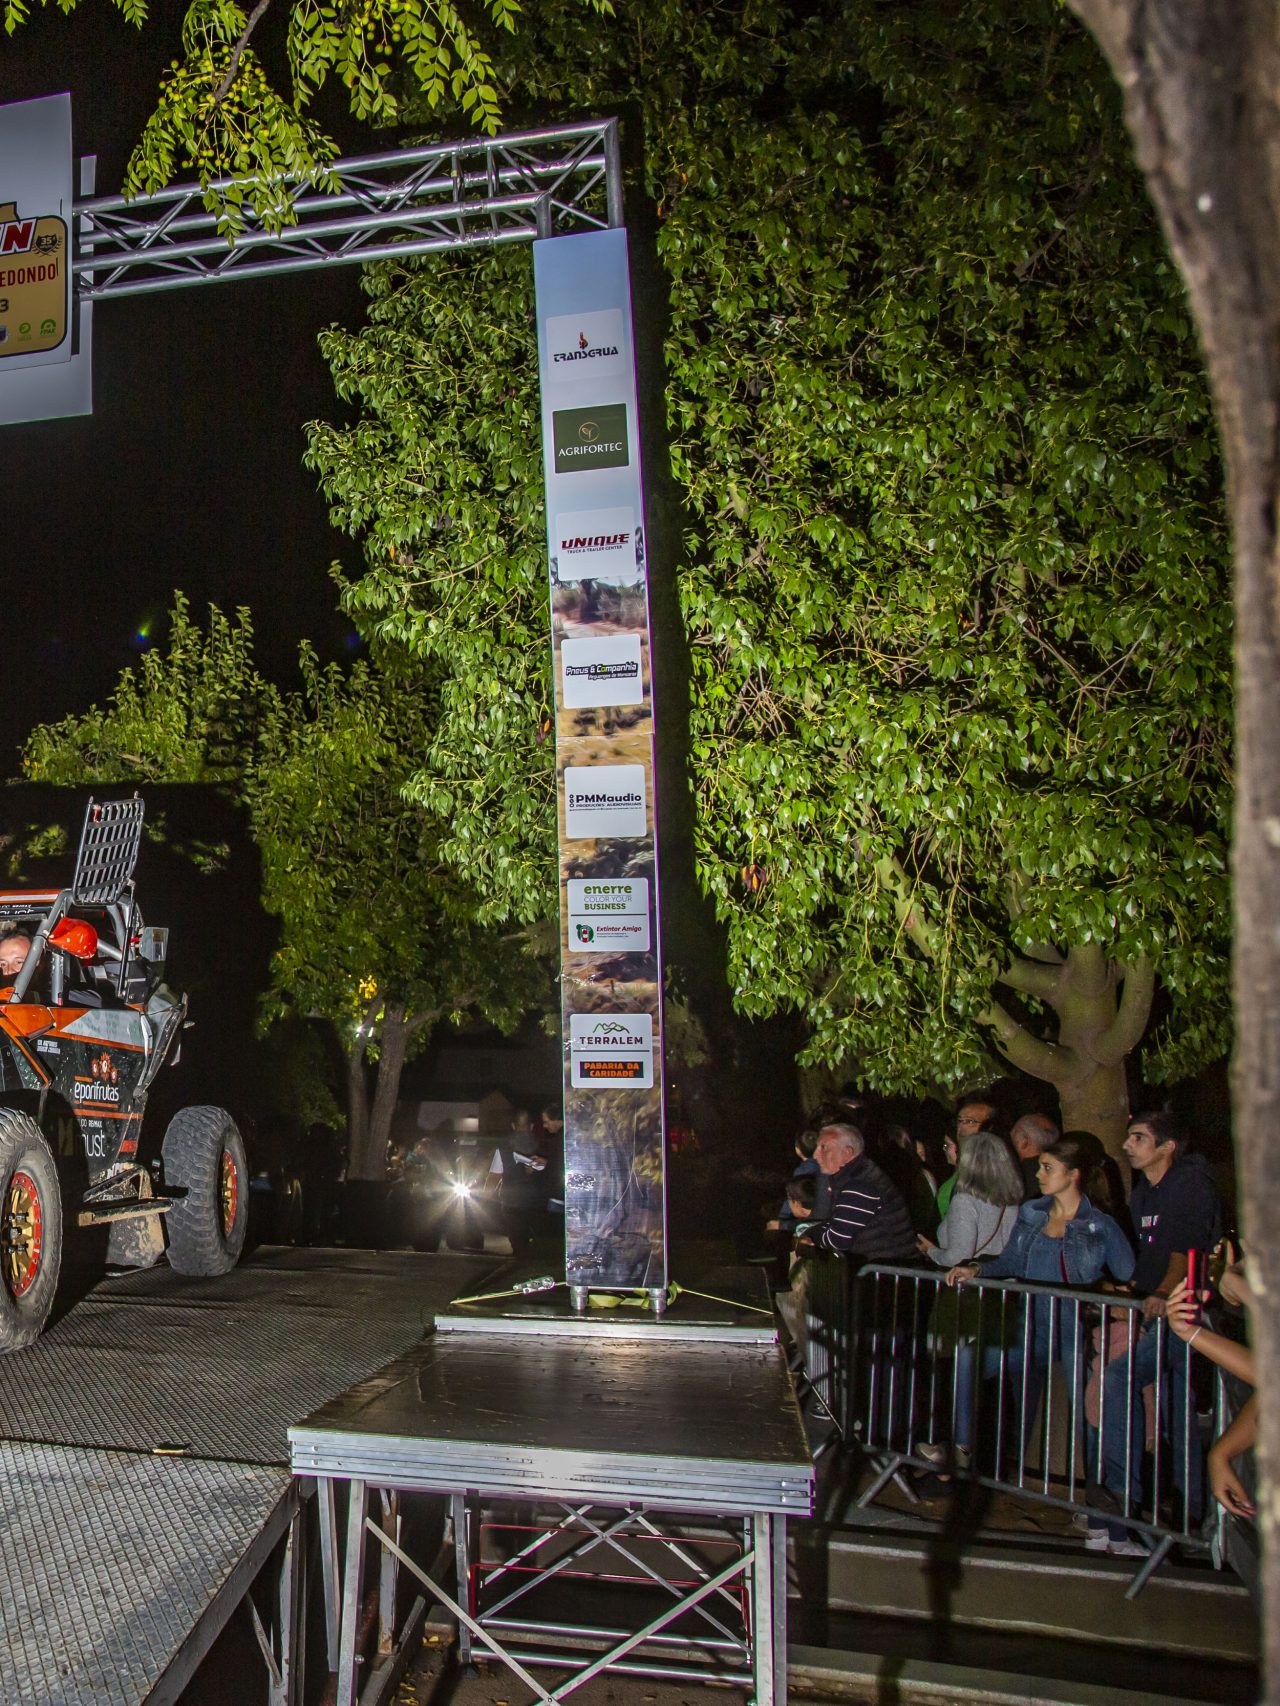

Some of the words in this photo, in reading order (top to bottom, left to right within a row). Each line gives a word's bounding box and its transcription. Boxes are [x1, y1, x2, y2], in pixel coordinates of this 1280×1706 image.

[553, 346, 619, 362] TRANSGRUA
[558, 442, 622, 457] AGRIFORTEC
[561, 533, 630, 549] UNIQUE
[566, 666, 589, 675] Pneus
[597, 662, 637, 673] Companhia
[576, 793, 641, 803] PMMaudio
[584, 885, 632, 894] enerre
[580, 1036, 643, 1044] TERRALEM
[74, 1081, 119, 1103] eporifrutas
